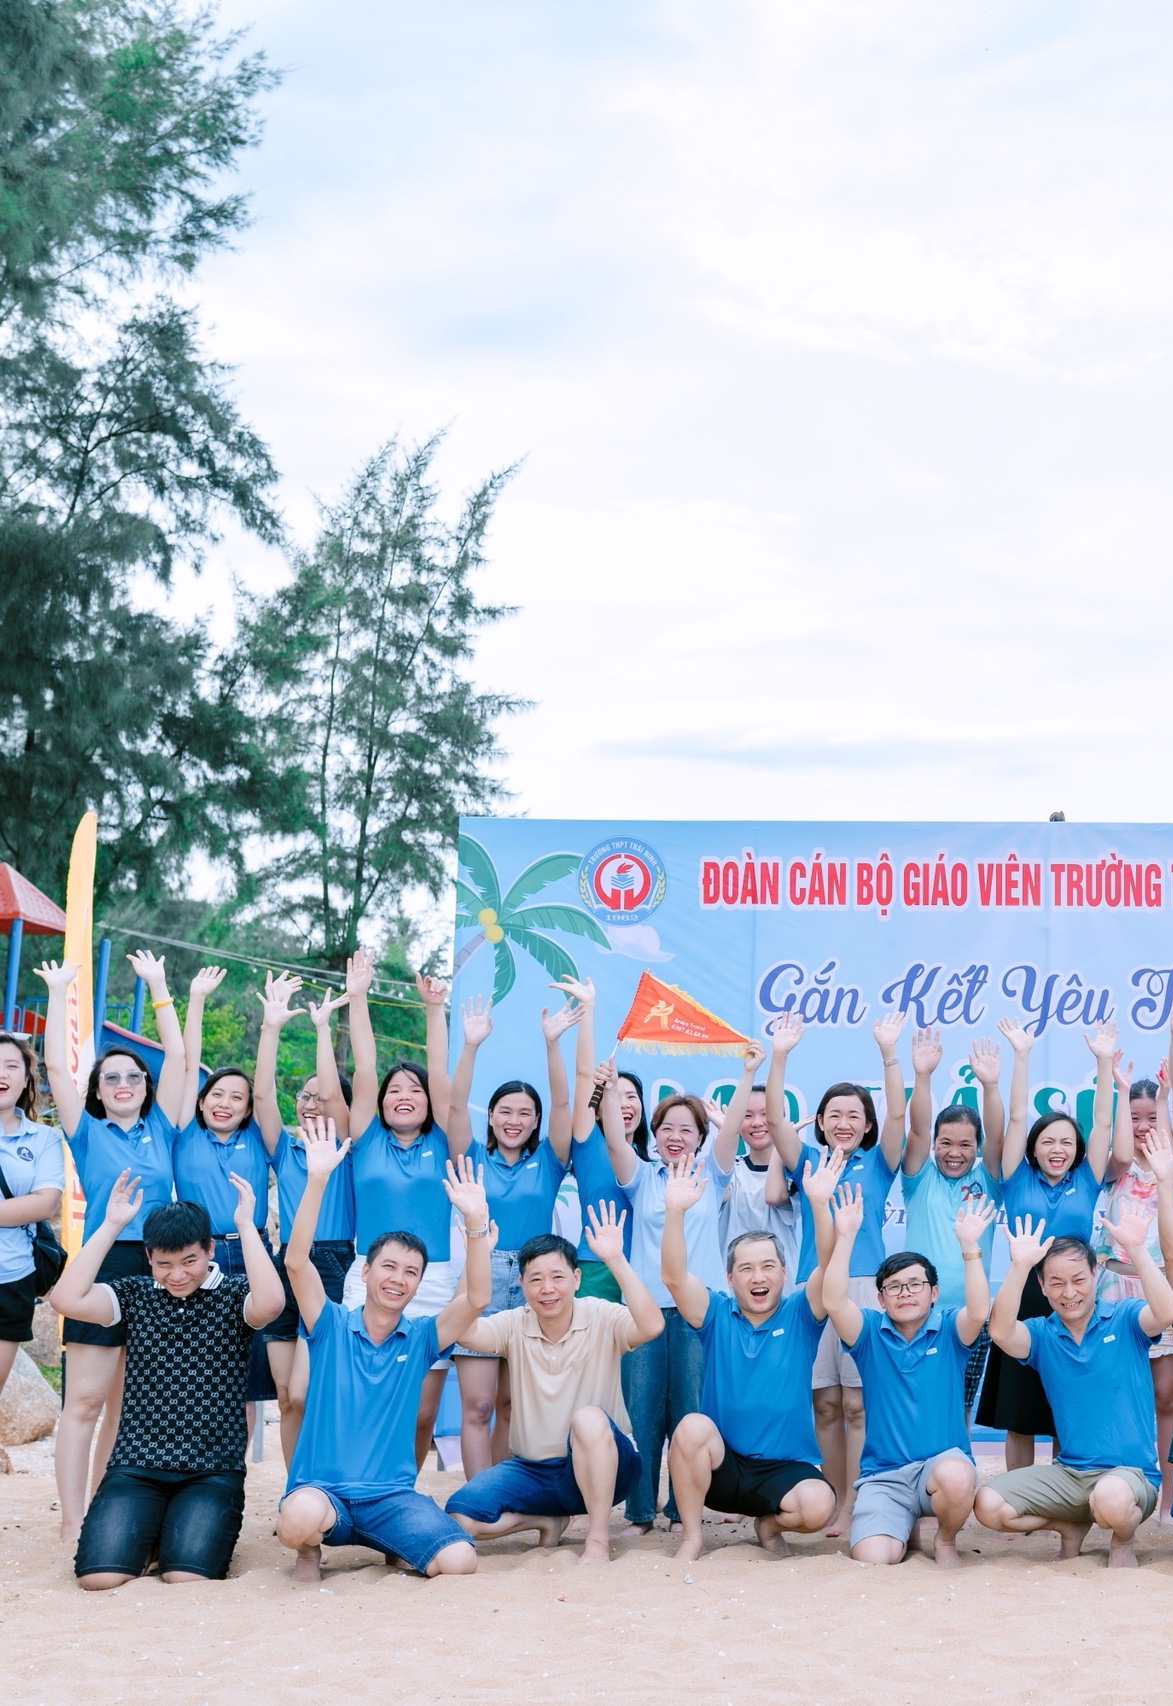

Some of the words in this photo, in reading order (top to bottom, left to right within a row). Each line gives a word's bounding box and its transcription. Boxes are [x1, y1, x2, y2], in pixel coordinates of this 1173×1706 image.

[611, 841, 628, 849] THPT
[643, 849, 659, 866] NINH
[702, 853, 779, 905] ĐOÀN
[789, 854, 847, 905] CÁN
[857, 853, 893, 916] BỘ
[903, 854, 968, 907] GIÁO
[977, 854, 1041, 906] VIÊN
[1050, 853, 1162, 907] TRƯỜNG
[605, 914, 639, 922] 1962
[759, 961, 867, 1036] Gắn
[882, 963, 990, 1029] Kết
[1001, 965, 1115, 1038] Yêu
